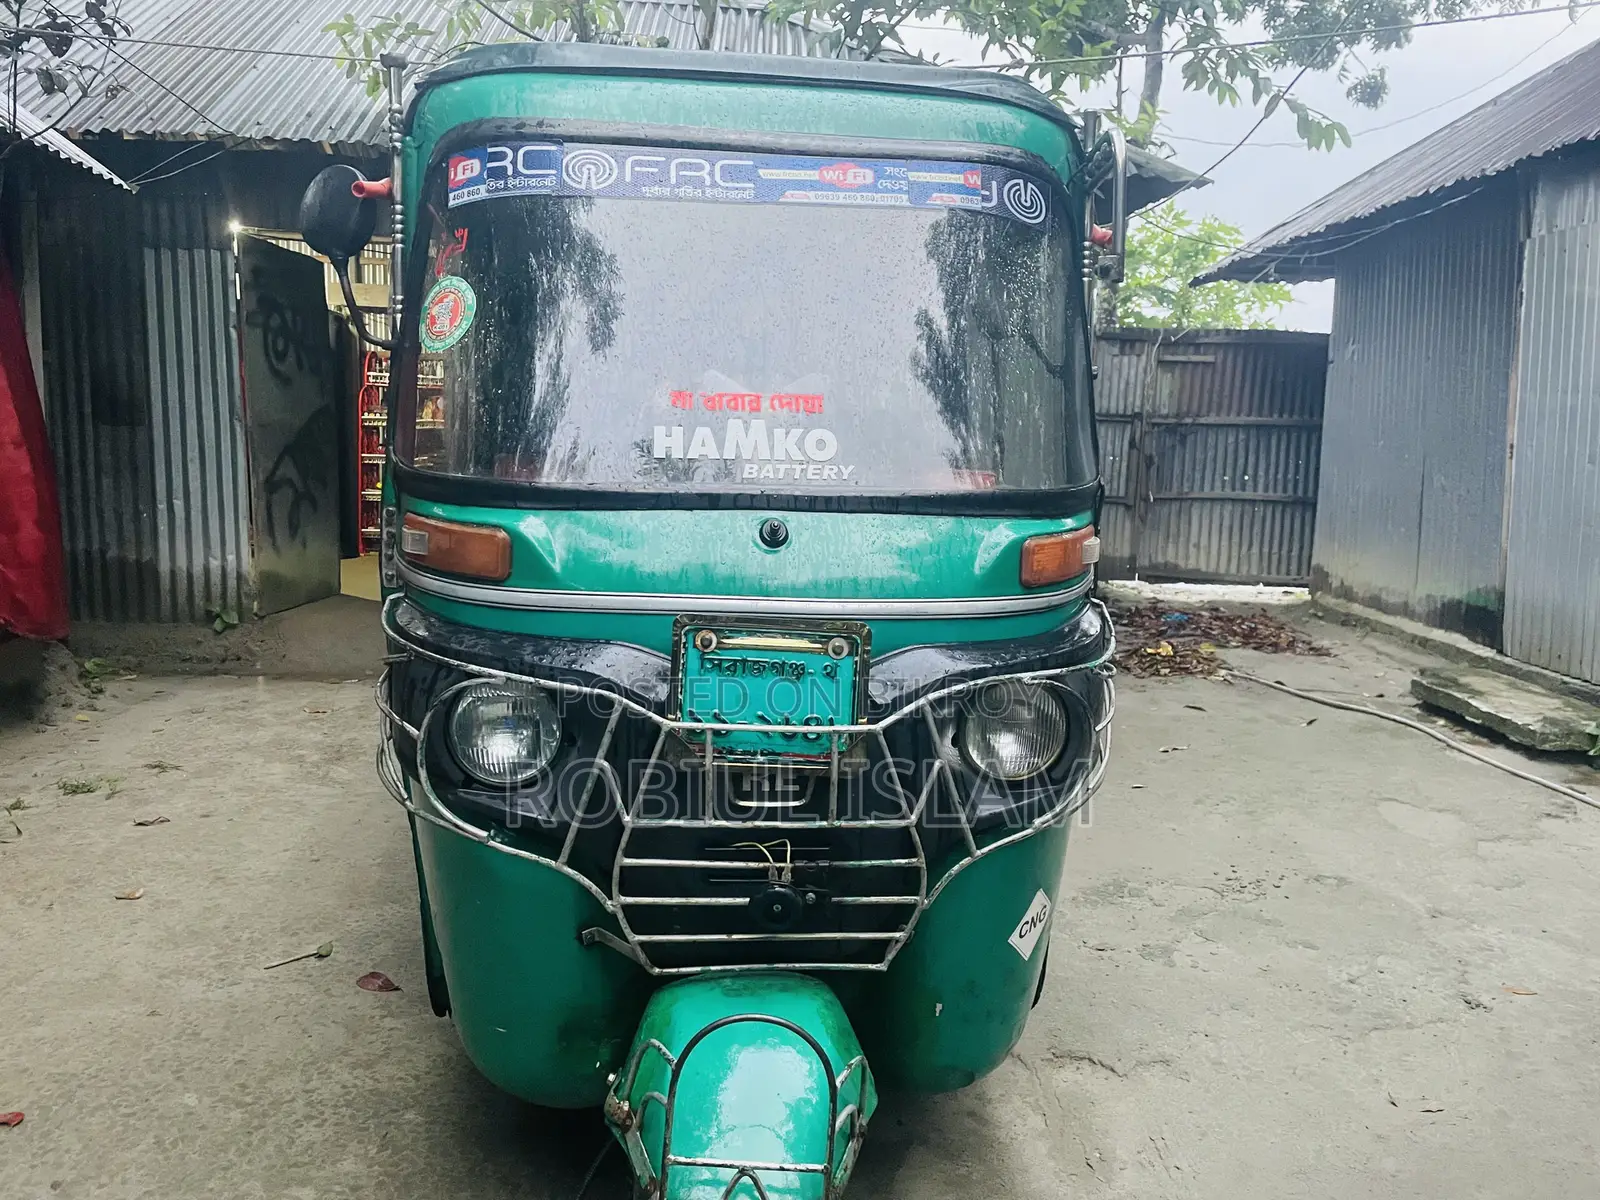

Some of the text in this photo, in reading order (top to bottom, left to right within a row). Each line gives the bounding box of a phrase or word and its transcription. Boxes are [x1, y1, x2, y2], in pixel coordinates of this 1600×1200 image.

[625, 155, 755, 187] FRC
[699, 392, 762, 412] বাবার
[653, 418, 838, 462] HAMKO
[742, 464, 855, 480] BATTERY
[1018, 904, 1048, 939] CNG
